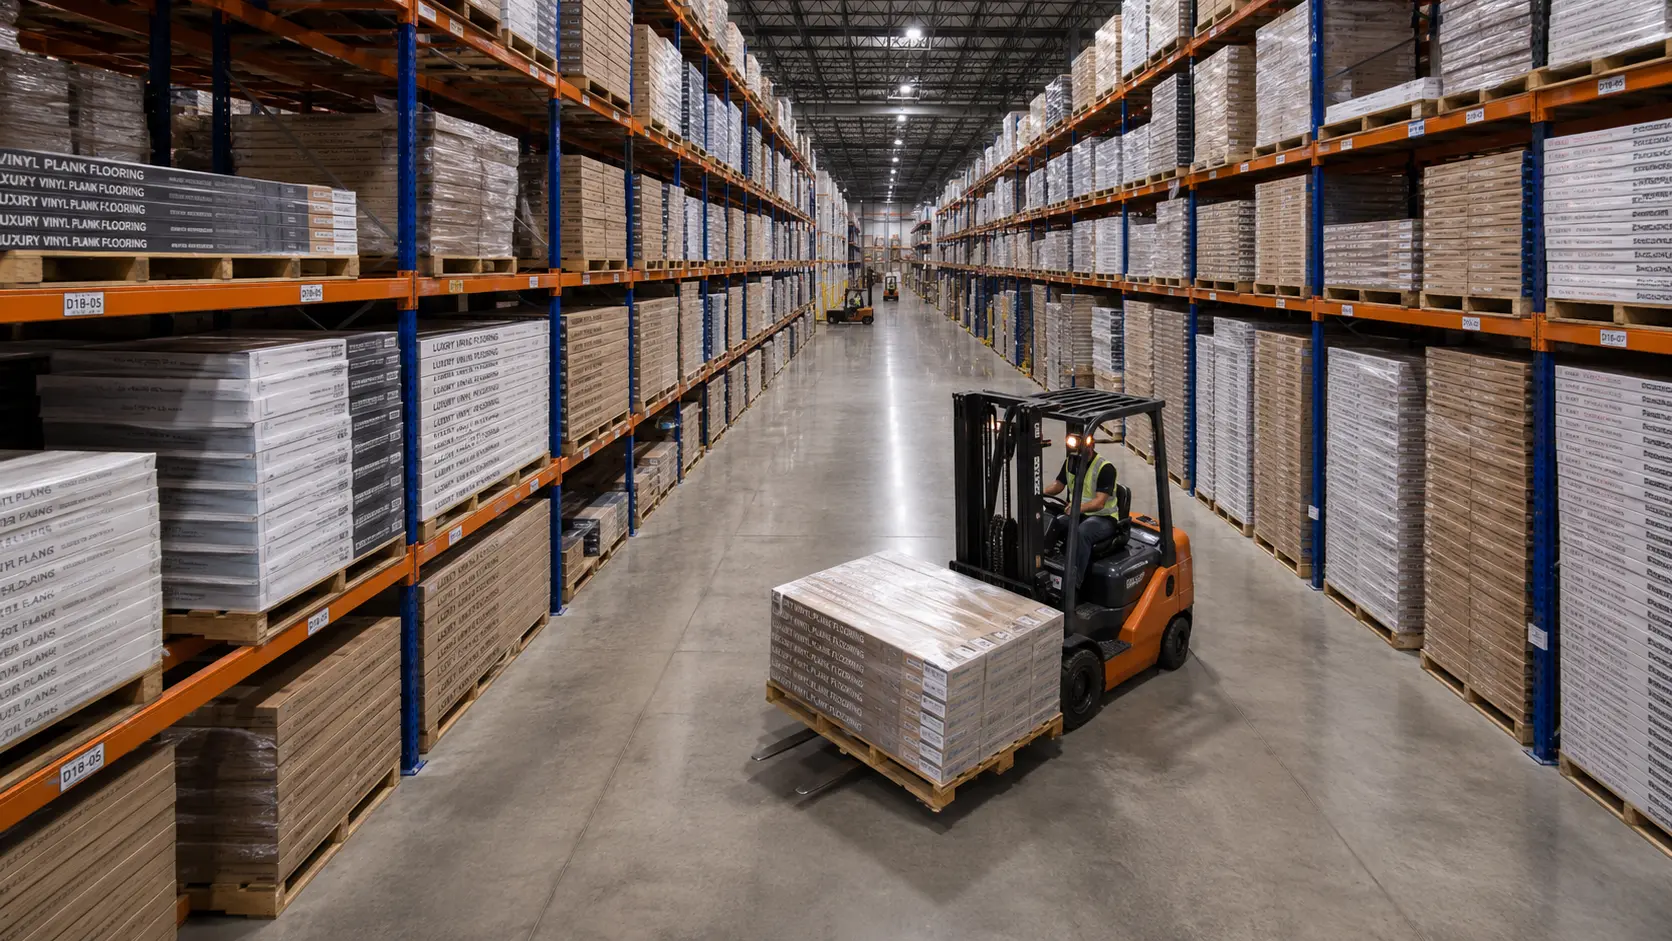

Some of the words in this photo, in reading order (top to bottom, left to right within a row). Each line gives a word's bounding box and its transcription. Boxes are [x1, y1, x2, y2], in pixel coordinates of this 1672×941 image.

[44, 159, 87, 173] PLANK
[90, 164, 145, 180] FLOORING
[39, 177, 69, 190] VINYL
[69, 180, 97, 193] PLANK
[99, 184, 145, 197] FLOORING
[41, 197, 69, 210] VINYL
[70, 200, 99, 212] PLANK
[42, 217, 70, 229] VINYL
[72, 219, 100, 229] PLANK
[101, 220, 147, 232] FLOORING
[43, 236, 71, 247] VINYL
[72, 237, 100, 247] PLANK
